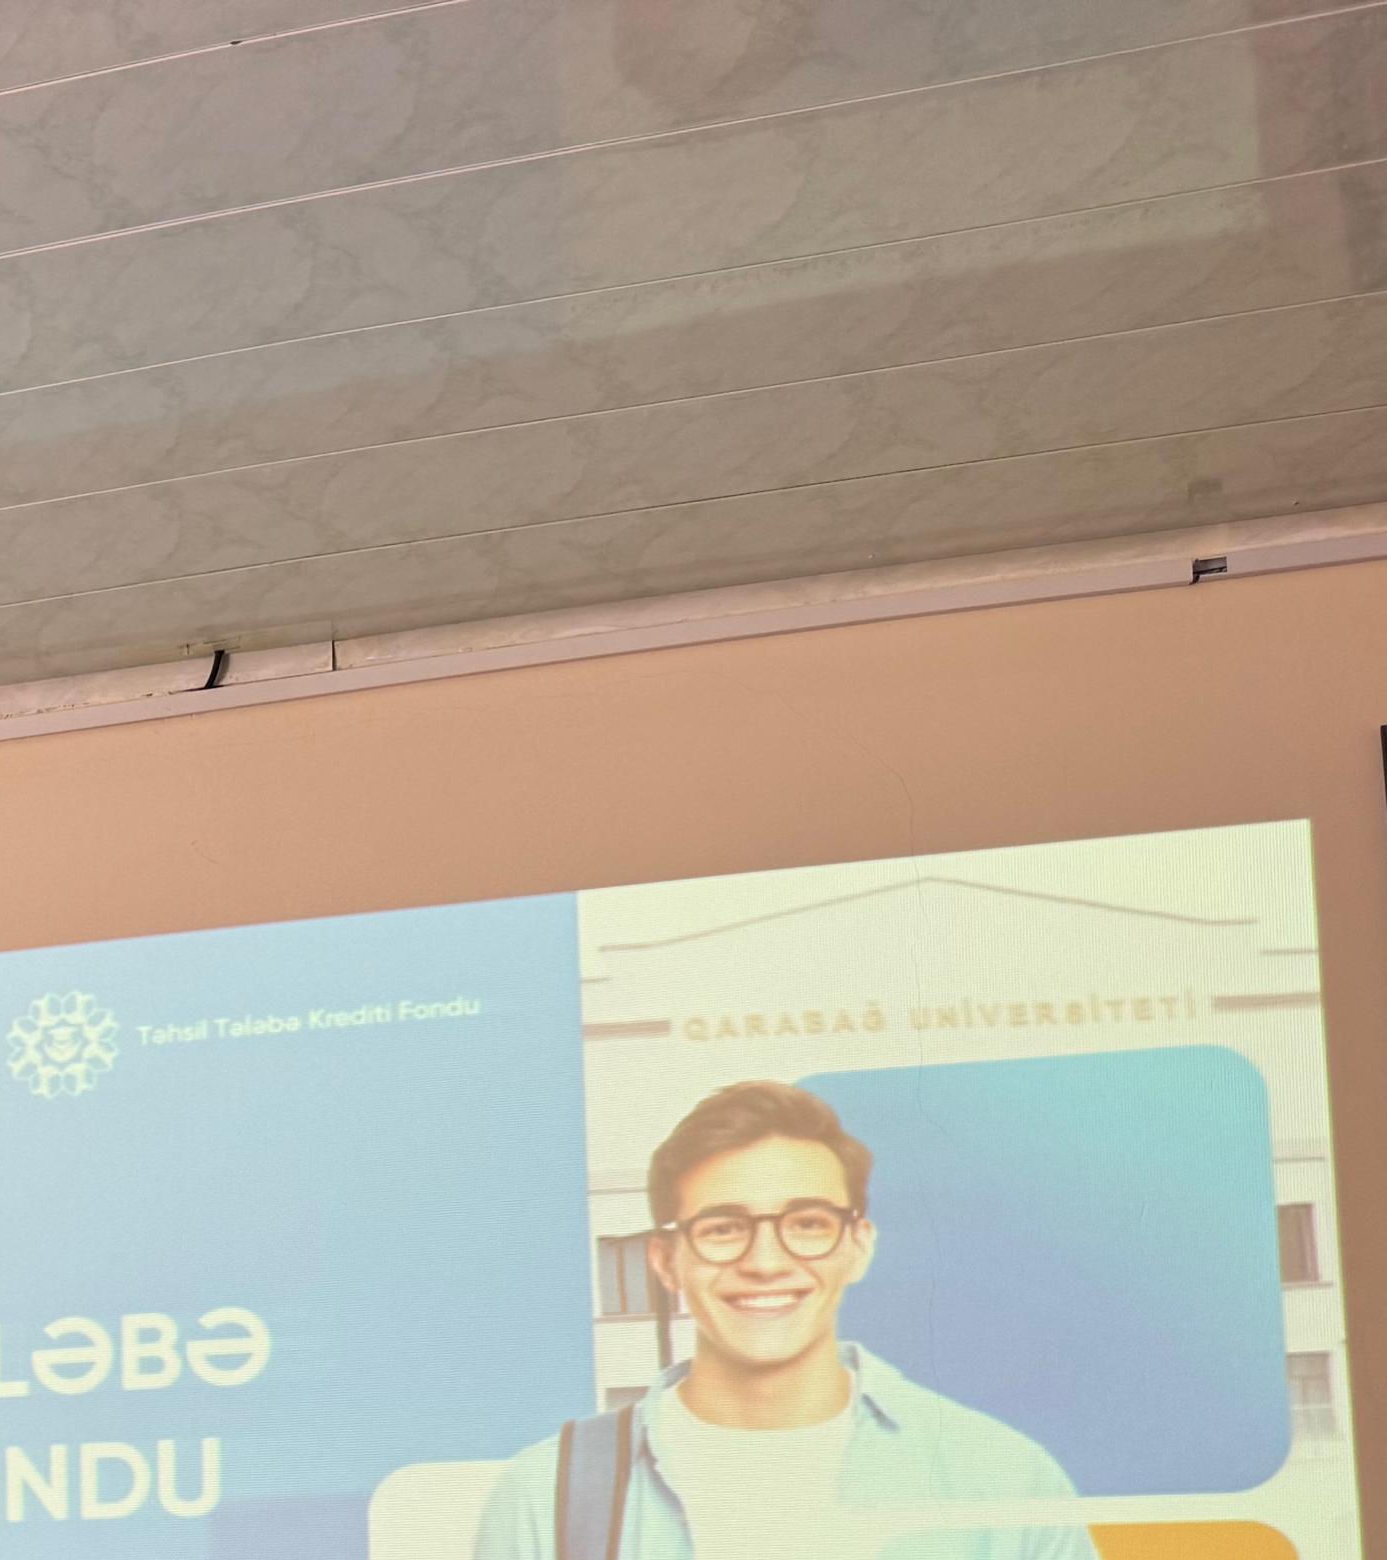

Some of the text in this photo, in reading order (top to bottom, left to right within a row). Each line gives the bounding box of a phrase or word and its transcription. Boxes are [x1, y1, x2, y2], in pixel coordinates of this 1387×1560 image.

[309, 1004, 392, 1030] Krediti
[398, 995, 482, 1021] Fondu
[682, 1000, 887, 1043] QARABAĞ
